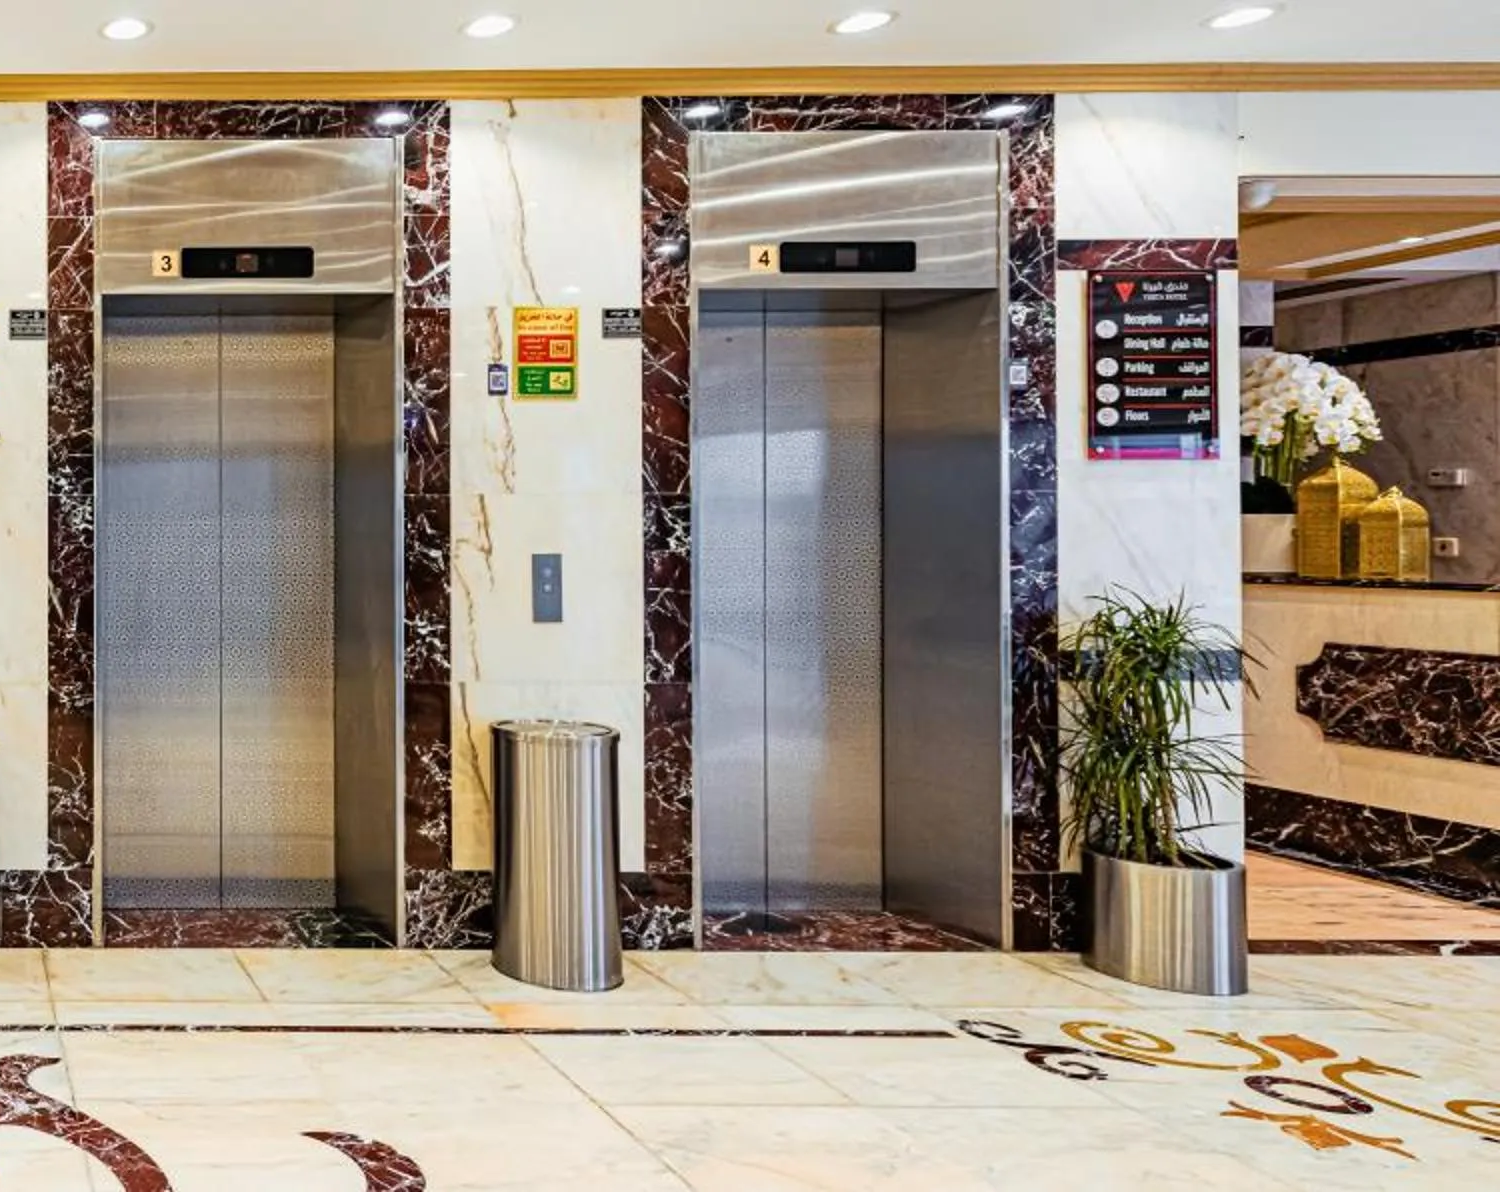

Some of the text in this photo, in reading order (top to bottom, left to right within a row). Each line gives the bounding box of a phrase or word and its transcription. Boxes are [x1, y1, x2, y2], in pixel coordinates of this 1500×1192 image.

[160, 255, 173, 273] 3
[757, 249, 771, 267] 4
[1123, 313, 1163, 326] Reception
[1123, 361, 1155, 375] Parking
[1124, 385, 1167, 397] Restaurant
[1124, 409, 1149, 421] Floors
